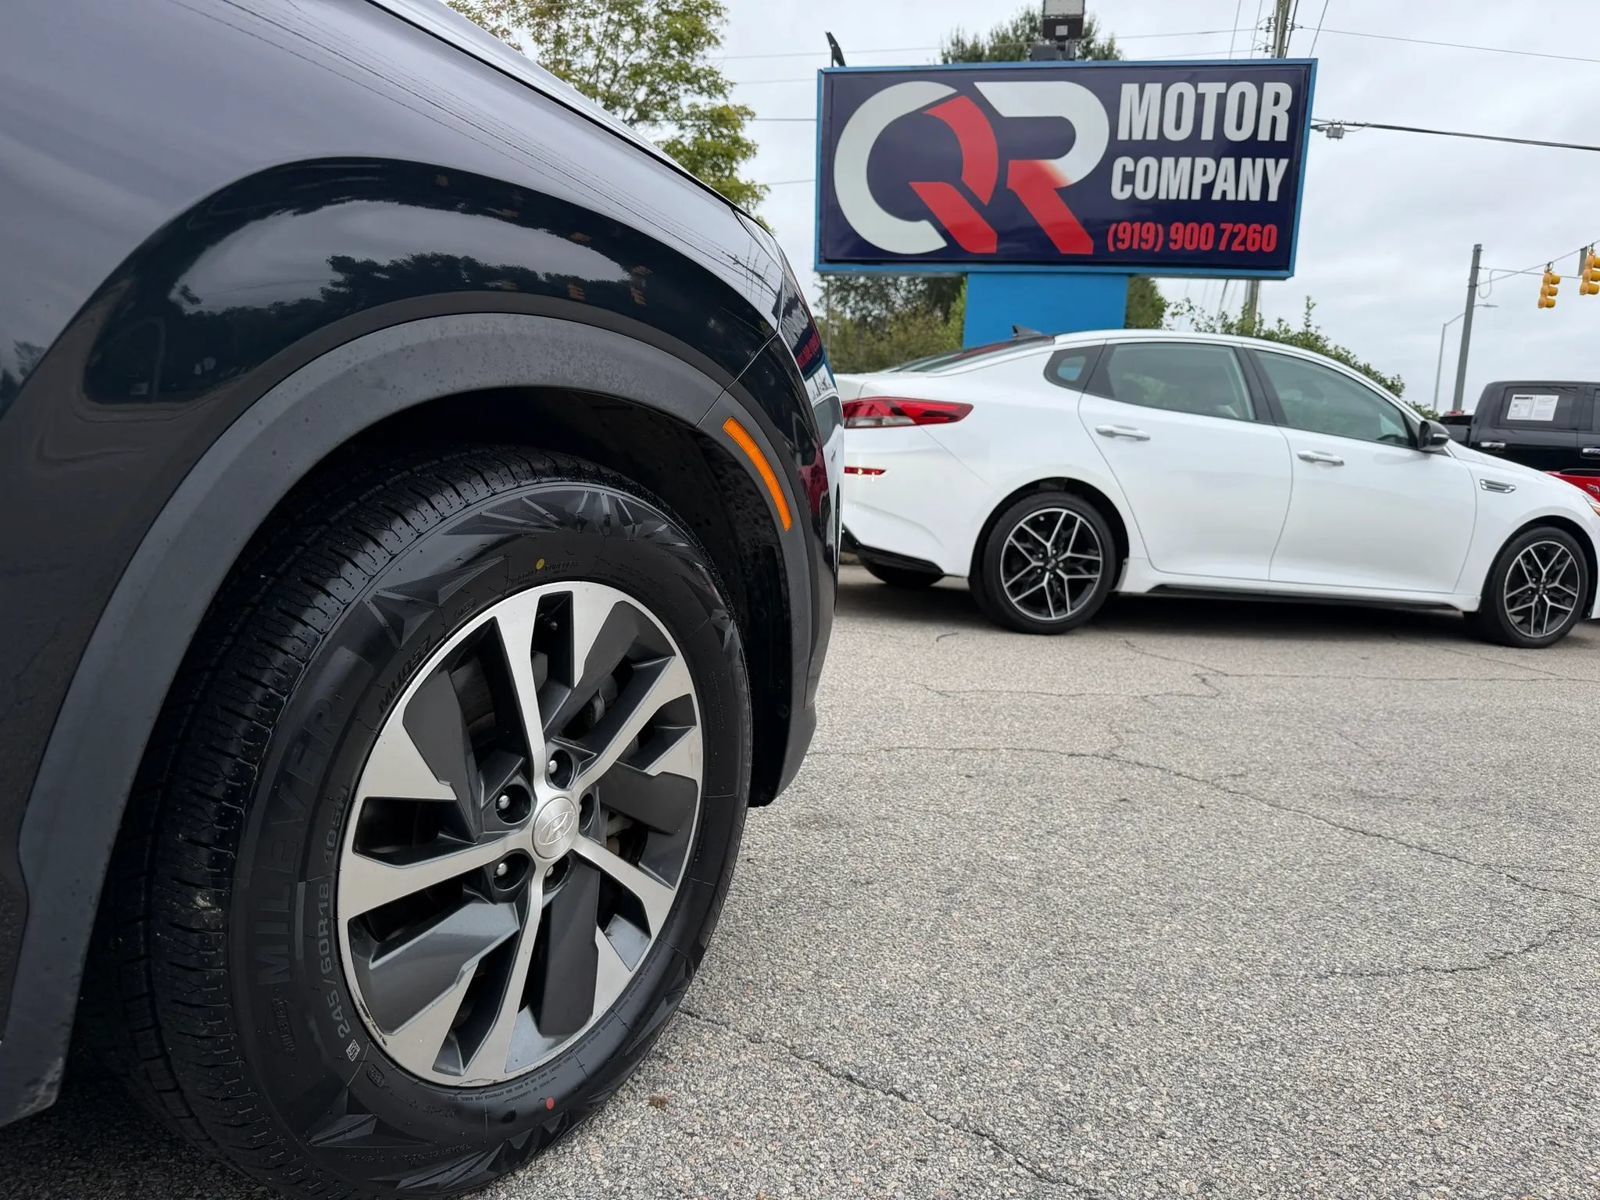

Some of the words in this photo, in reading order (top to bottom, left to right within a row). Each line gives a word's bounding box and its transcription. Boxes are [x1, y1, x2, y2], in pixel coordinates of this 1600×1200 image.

[1117, 81, 1293, 142] MOTOR
[834, 81, 1110, 254] QR
[1111, 156, 1289, 202] COMPANY
[1107, 222, 1163, 252] (919)
[1169, 222, 1214, 251] 900
[1219, 223, 1277, 253] 7260
[256, 694, 343, 985] MILEVER
